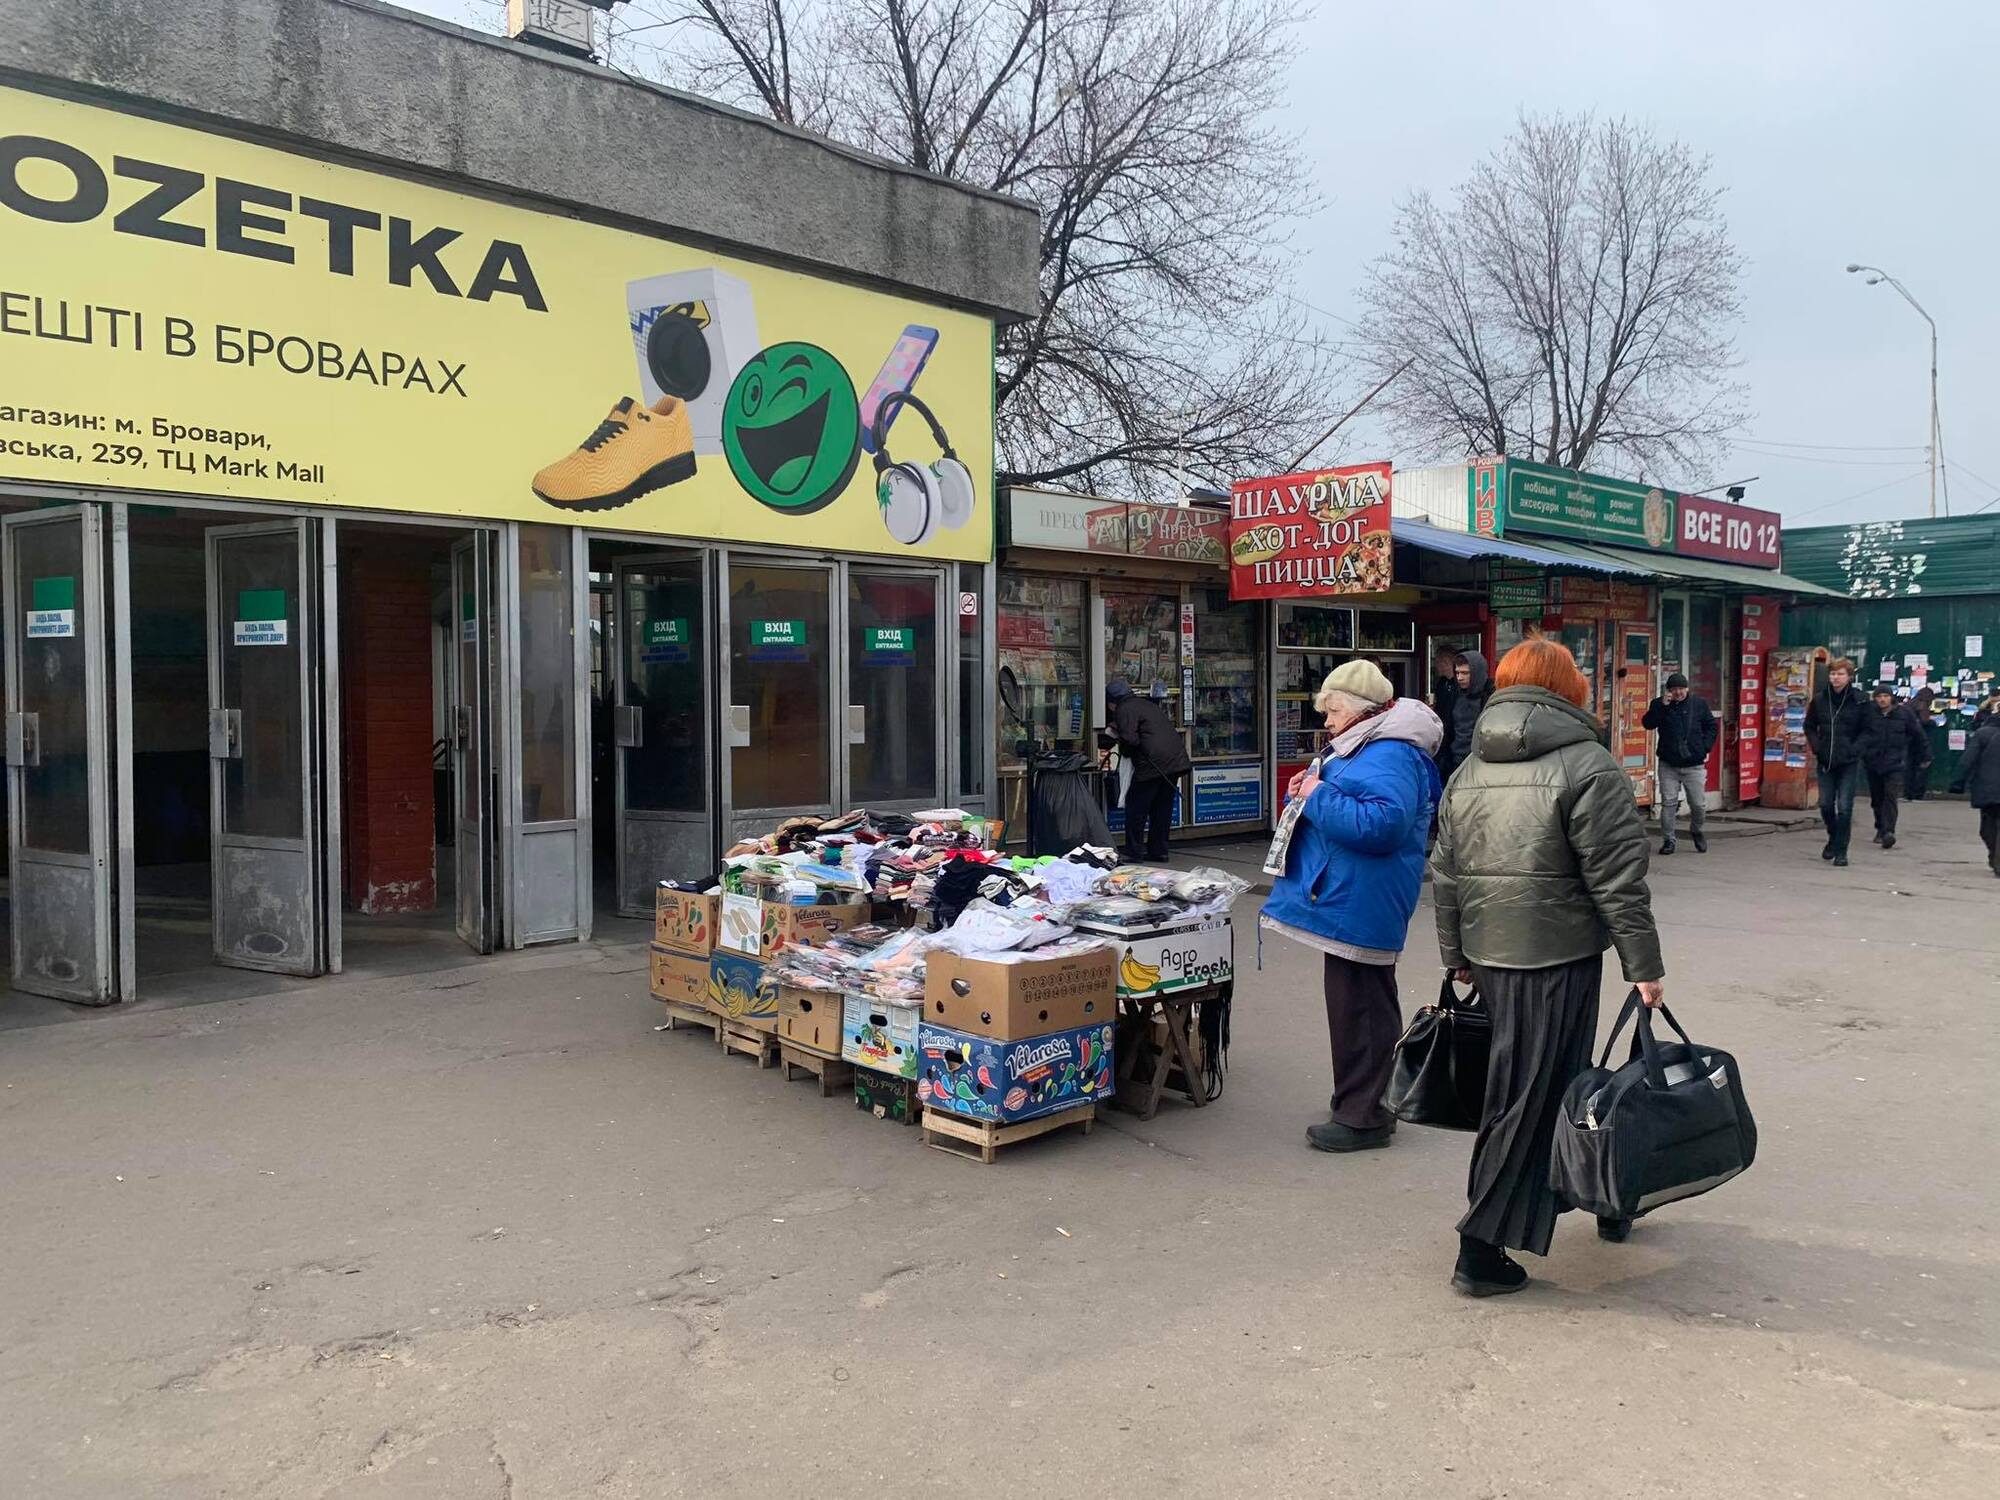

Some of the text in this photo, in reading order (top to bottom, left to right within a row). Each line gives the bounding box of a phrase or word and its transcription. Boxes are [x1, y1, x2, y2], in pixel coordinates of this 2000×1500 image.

[0, 135, 549, 312] OZETKA
[0, 291, 468, 398] ЕШТІ В БРОВАРАХ
[0, 406, 272, 451] агазин: м. Бровари,
[92, 443, 148, 469] 239,
[157, 449, 196, 475] ТЦ
[205, 454, 269, 479] Mark
[276, 461, 324, 483] Mall
[1233, 475, 1384, 520] ШАУРМА
[1248, 518, 1368, 551] ХОТ-ДОГ
[1684, 509, 1777, 554] ВСЕ ПО 12
[1254, 555, 1358, 588] ПИЦЦА
[653, 620, 677, 633] ВХІД
[764, 621, 792, 635] ВХІД
[877, 629, 902, 641] ВХІД
[1161, 948, 1198, 971] Agro
[1183, 956, 1230, 983] Fresh
[919, 1028, 957, 1049] Velarosa
[1005, 1038, 1072, 1080] Velarosa
